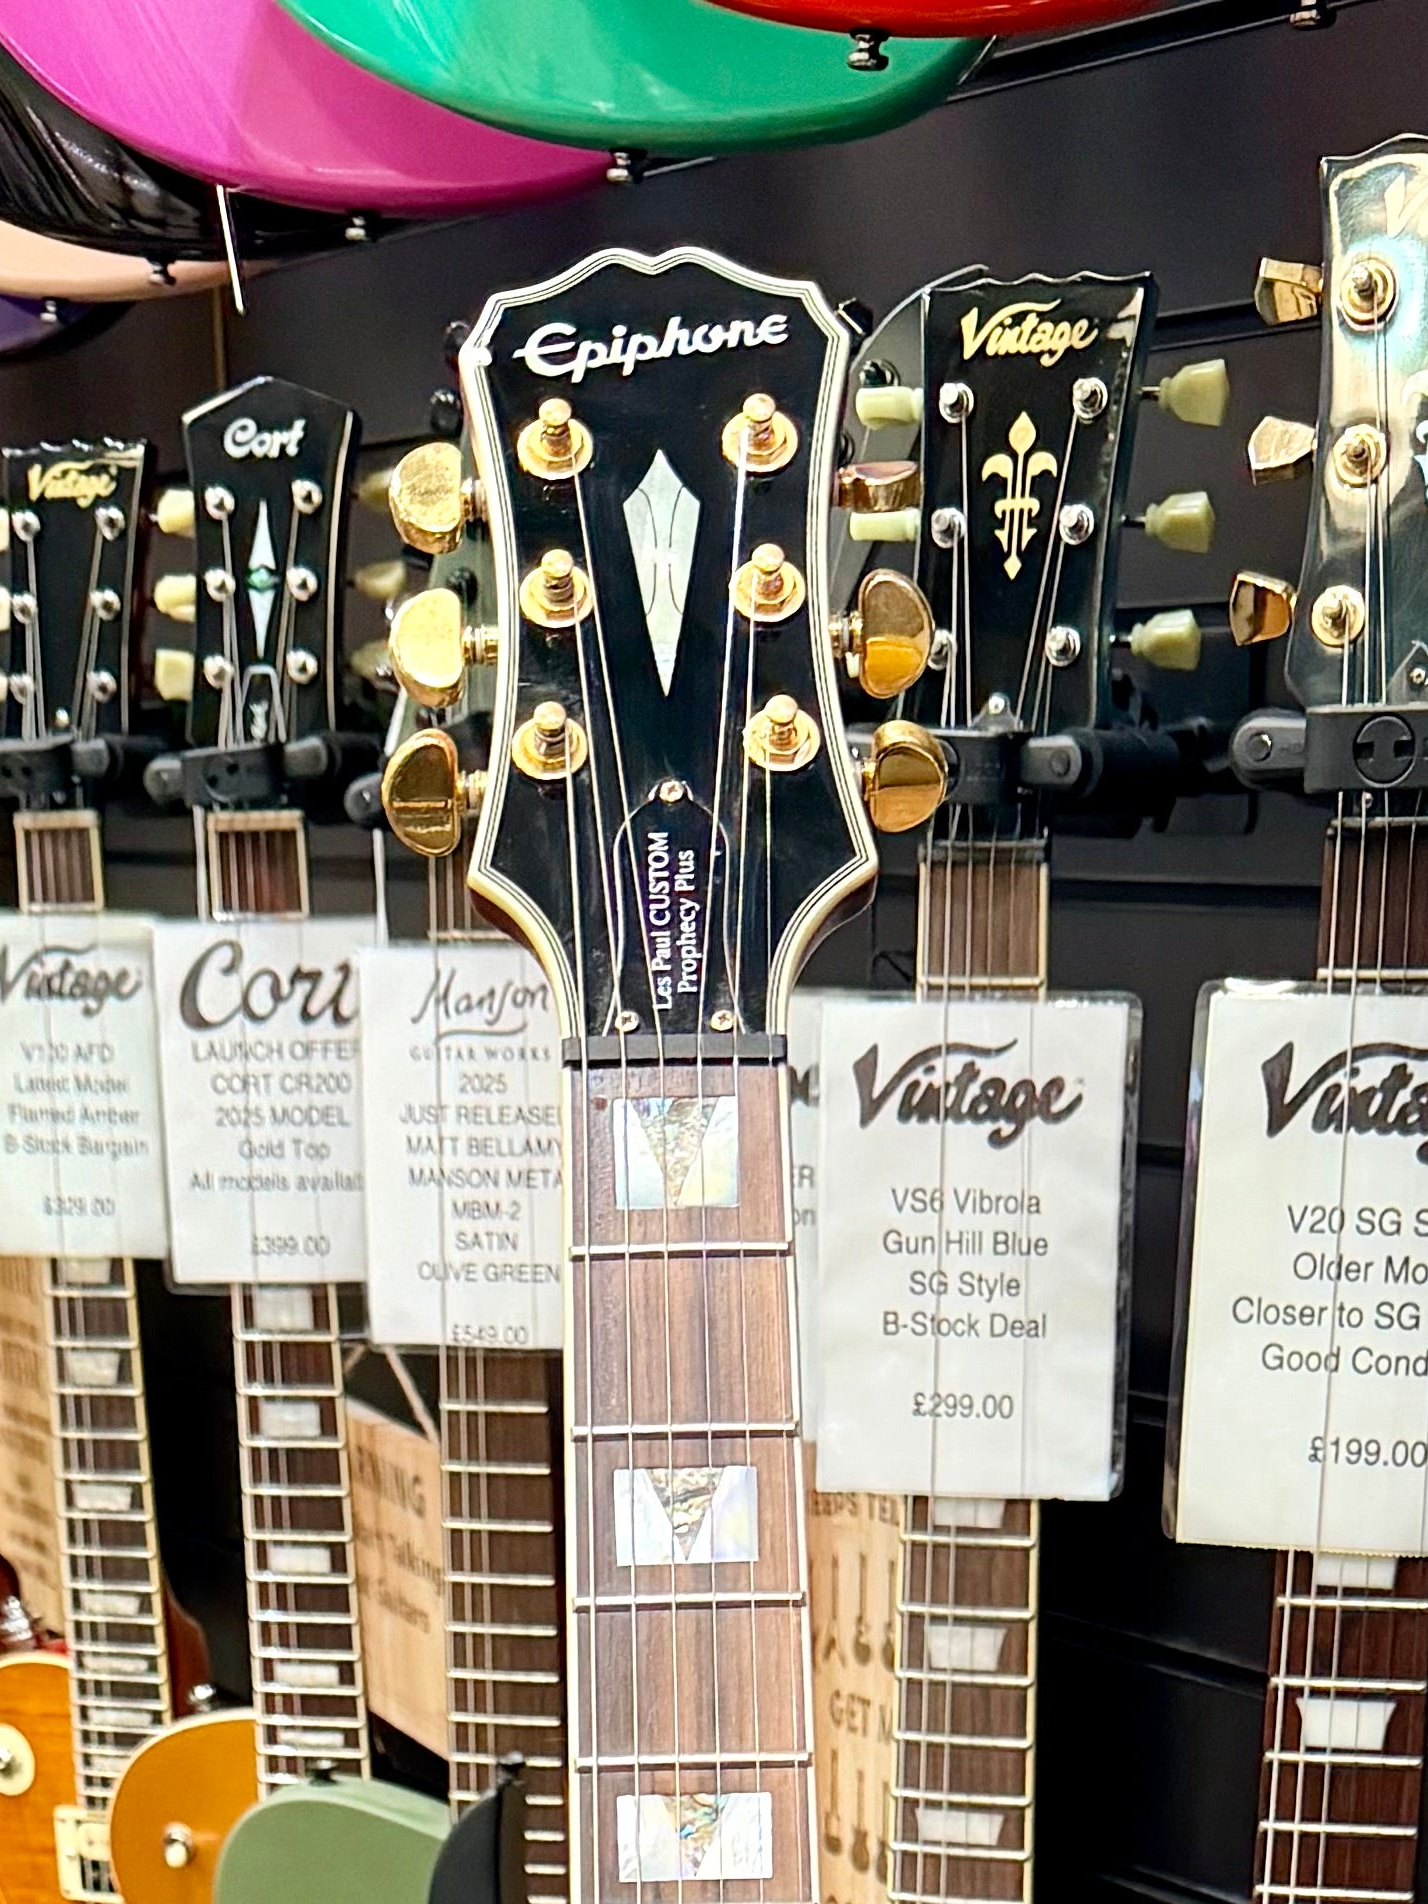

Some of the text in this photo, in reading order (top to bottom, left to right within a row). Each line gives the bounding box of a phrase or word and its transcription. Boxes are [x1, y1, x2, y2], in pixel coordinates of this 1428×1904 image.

[960, 299, 1098, 367] Vintage
[512, 313, 790, 383] Epiphone
[223, 417, 307, 460] Cort
[27, 461, 119, 508] Vintage
[647, 832, 673, 1012] Les Paul CUSTOM
[674, 850, 704, 994] Prophecy Plus
[410, 966, 549, 1027] Manson
[191, 1040, 283, 1063] LAUNCH
[485, 1046, 552, 1063] WORKS
[211, 1074, 352, 1096] CORT CR200
[458, 1074, 508, 1094] 2025
[853, 1038, 1083, 1150] Vintage
[215, 1107, 351, 1128] 2025 MODEL
[399, 1105, 449, 1126] JUST
[238, 1139, 331, 1163] Gold Top
[405, 1136, 460, 1156] MATT
[188, 1173, 291, 1192] All models
[408, 1168, 563, 1189] MANSON META
[451, 1200, 522, 1221] MBM-2
[891, 1188, 1041, 1215] VS6 Vibrola
[1287, 1204, 1345, 1236] V20
[1354, 1206, 1402, 1238] SG
[251, 1235, 330, 1257] £399.00
[455, 1231, 519, 1252] SATIN
[883, 1229, 1049, 1257] Gun Hill Blue
[418, 1262, 560, 1284] OLIVE GREEN
[1292, 1251, 1373, 1283] Older
[909, 1271, 1021, 1303] SG Style
[883, 1312, 1047, 1339] B-Stock Deal
[1232, 1296, 1328, 1327] Closer
[1337, 1300, 1363, 1328] to
[1374, 1302, 1421, 1331] SG
[1262, 1343, 1340, 1374] Good
[912, 1393, 1015, 1420] £299.00
[1307, 1436, 1428, 1468] £199.00
[829, 1690, 871, 1738] GET
